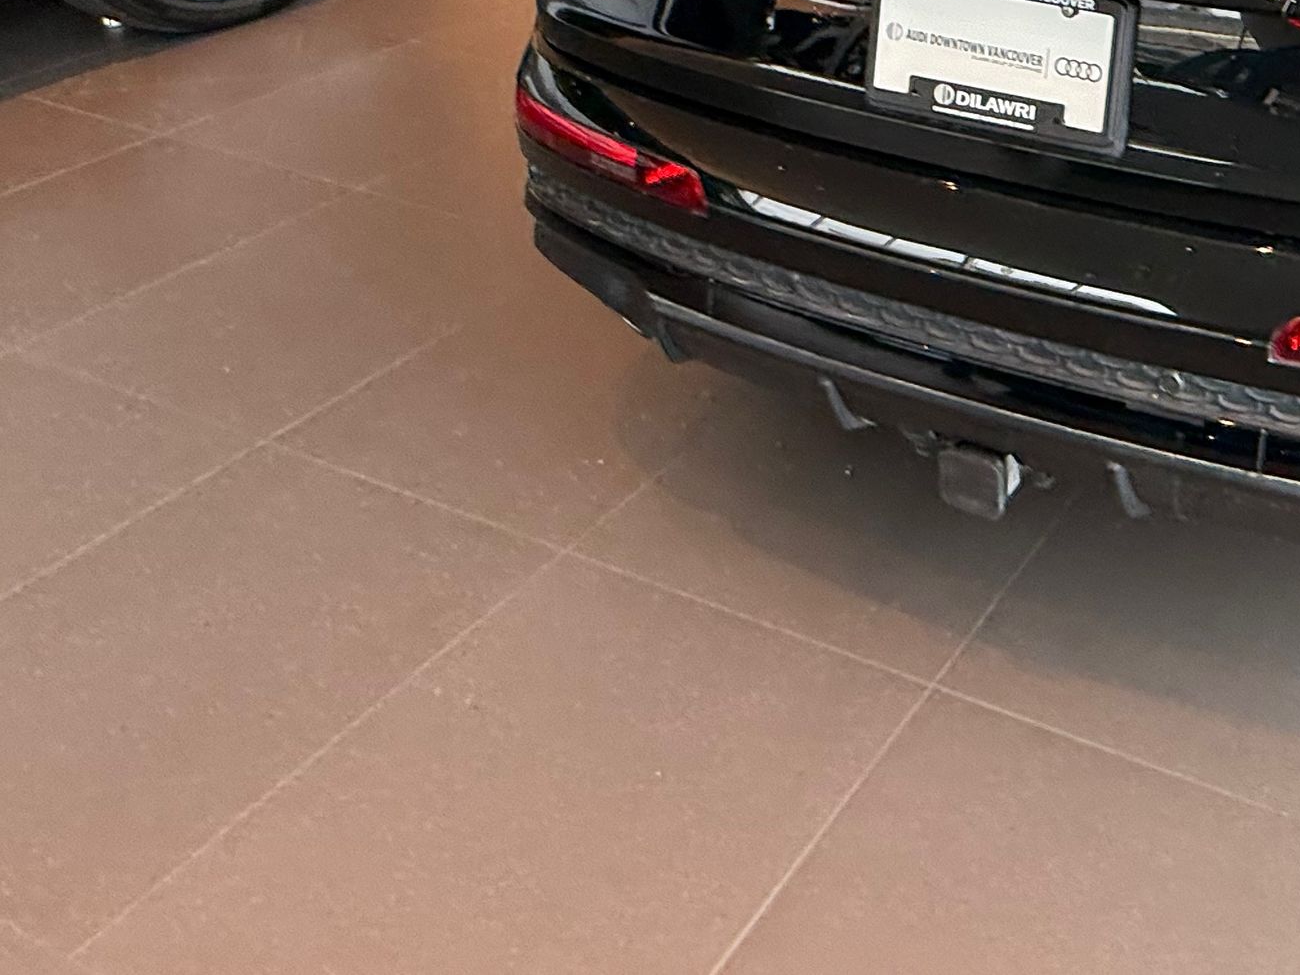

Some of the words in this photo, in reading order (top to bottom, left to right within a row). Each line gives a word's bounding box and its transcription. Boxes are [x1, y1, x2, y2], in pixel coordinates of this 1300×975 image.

[906, 29, 928, 43] AUDI
[930, 33, 985, 55] DOWNTOWN
[987, 44, 1043, 67] VANCOUVER
[955, 90, 1036, 120] DILAWRI
